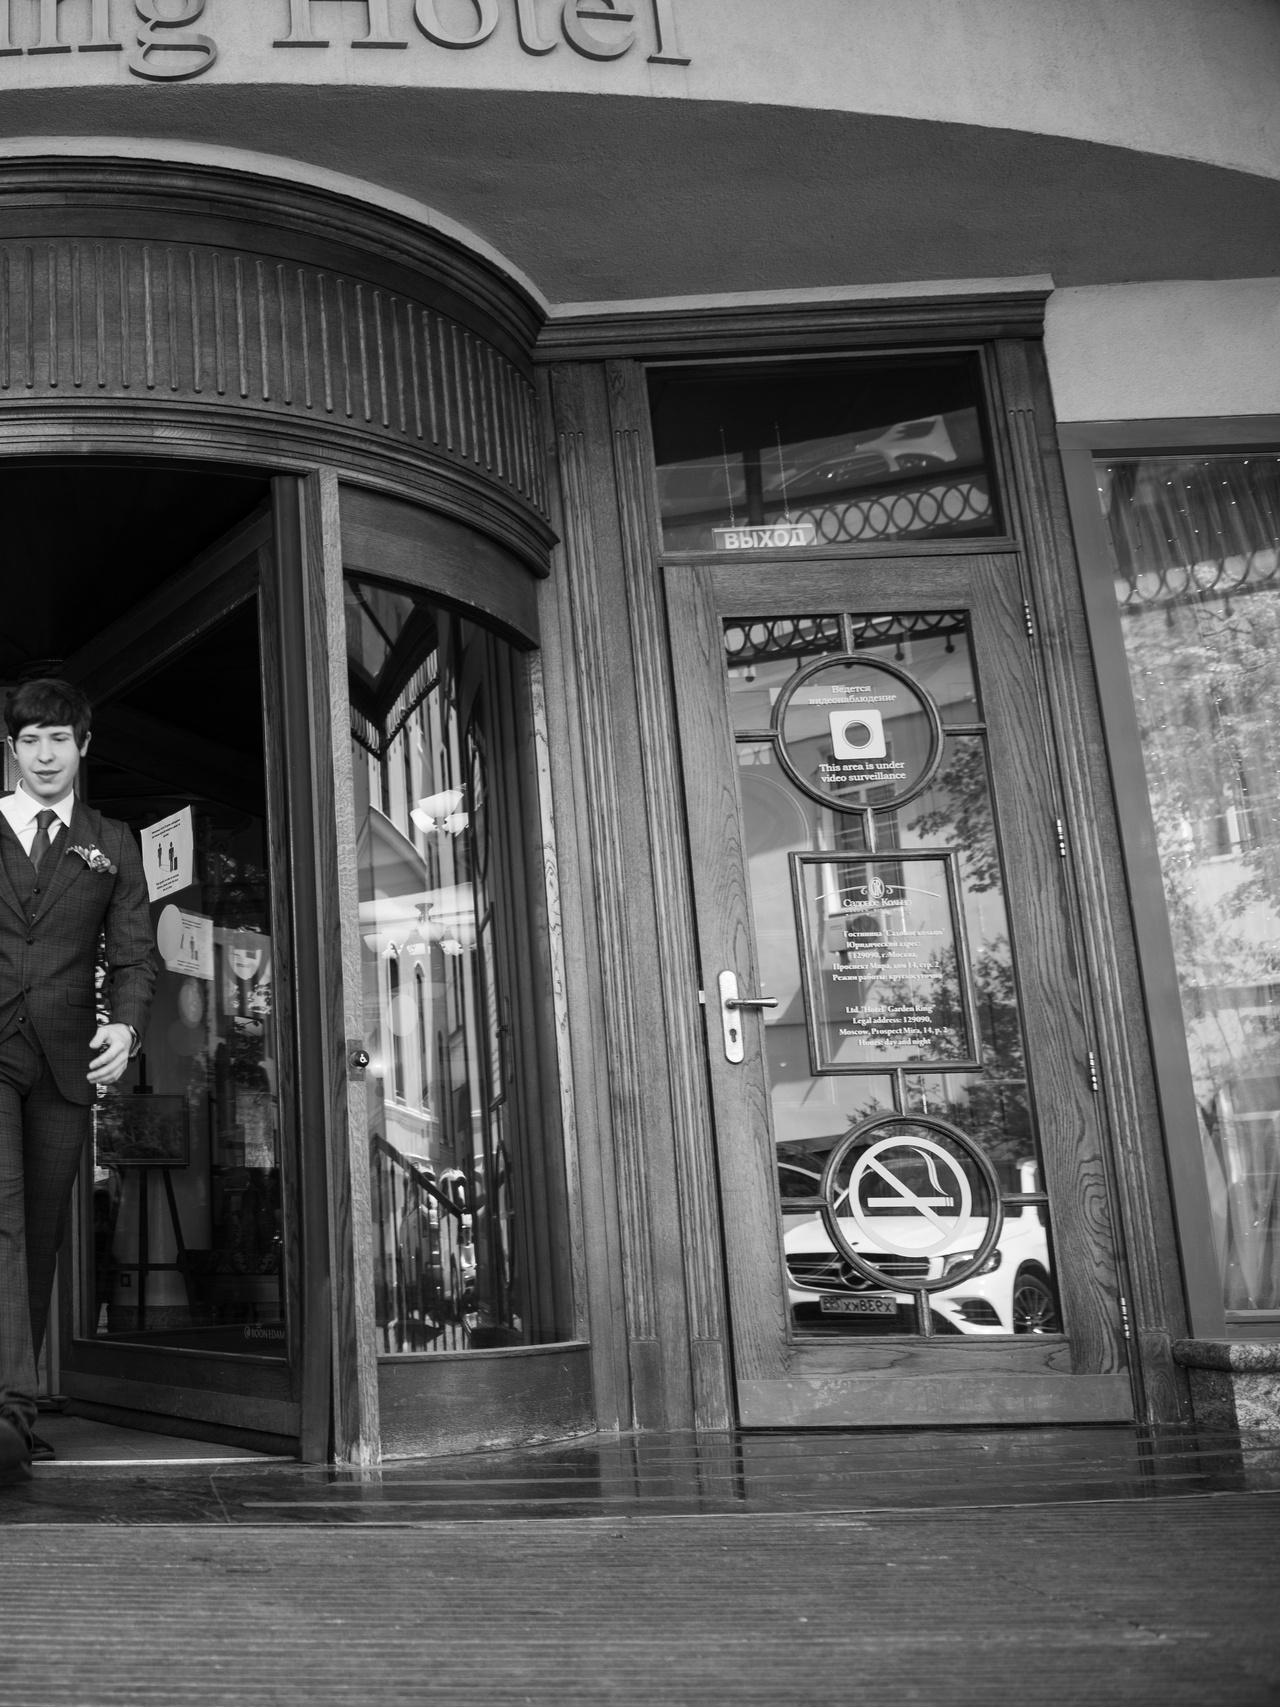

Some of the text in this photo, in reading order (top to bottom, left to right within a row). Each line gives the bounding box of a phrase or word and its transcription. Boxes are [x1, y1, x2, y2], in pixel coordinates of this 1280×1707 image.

[724, 529, 807, 549] ВЫХОД
[832, 685, 871, 693] Ведется
[808, 694, 897, 706] видеонаблюдение
[819, 761, 905, 772] This area is under
[820, 772, 906, 782] video surveillance
[833, 963, 869, 972] Проспект
[845, 1006, 861, 1014] Ltd.
[852, 1017, 872, 1026] Legal
[872, 1016, 902, 1024] address:
[839, 1028, 871, 1036] Moscow,
[871, 1027, 903, 1036] Prospect
[884, 1038, 897, 1048] day
[912, 1037, 931, 1048] night
[251, 1328, 286, 1340] BOON EDAM
